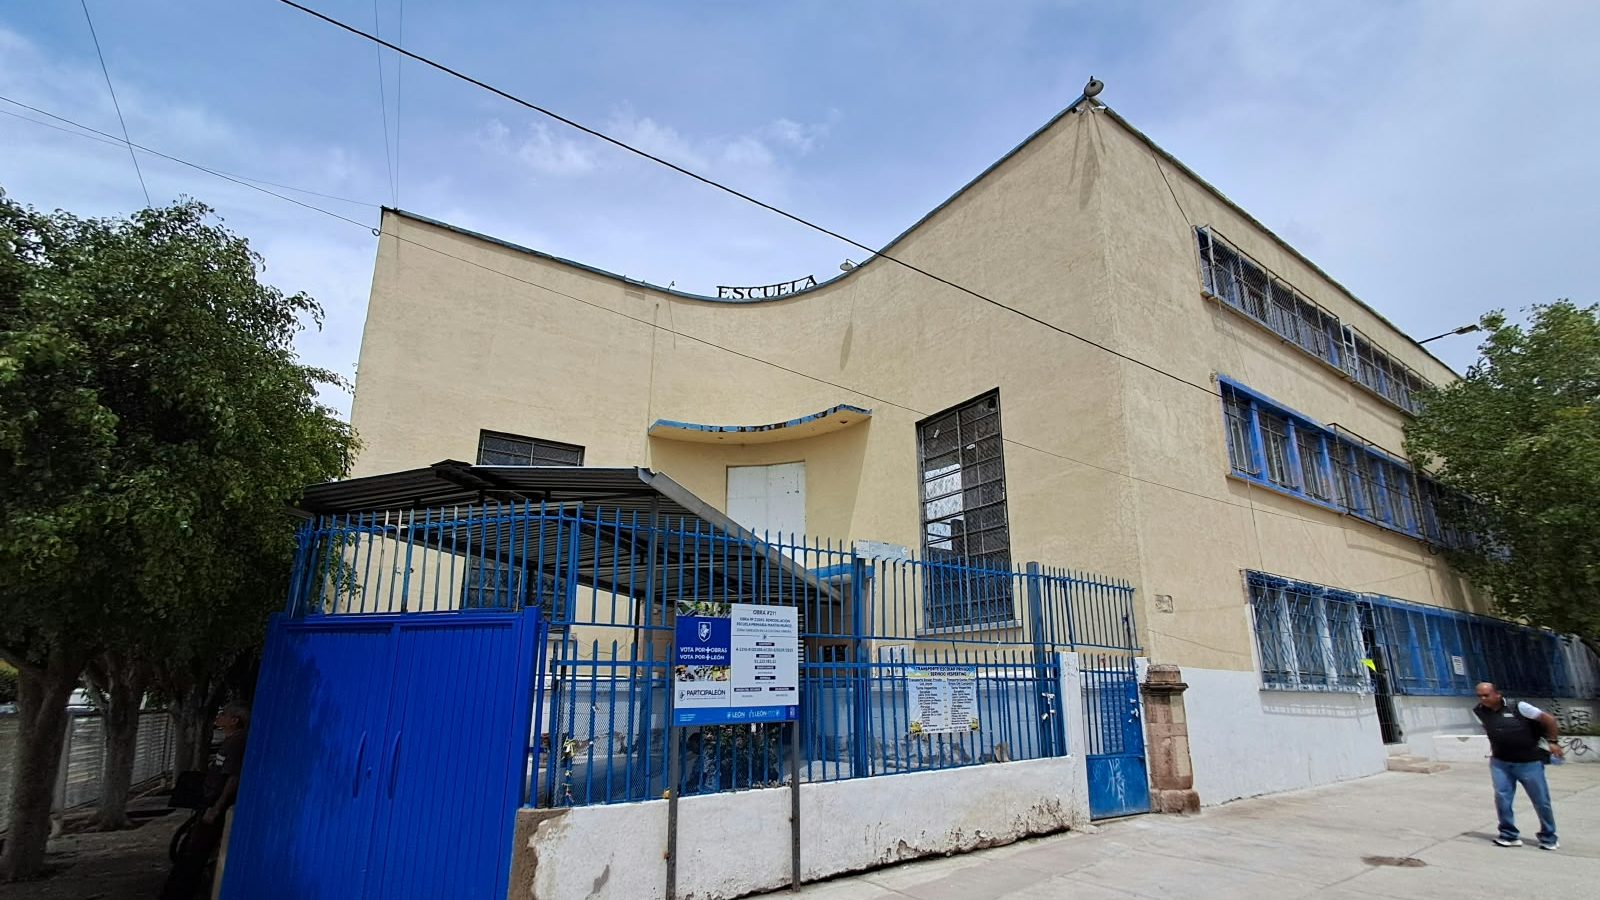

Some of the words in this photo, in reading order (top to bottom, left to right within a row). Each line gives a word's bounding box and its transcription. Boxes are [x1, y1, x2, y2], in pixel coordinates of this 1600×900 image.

[716, 275, 817, 299] ESCUELA
[731, 711, 746, 719] LEÓN
[754, 709, 767, 717] LEÓN
